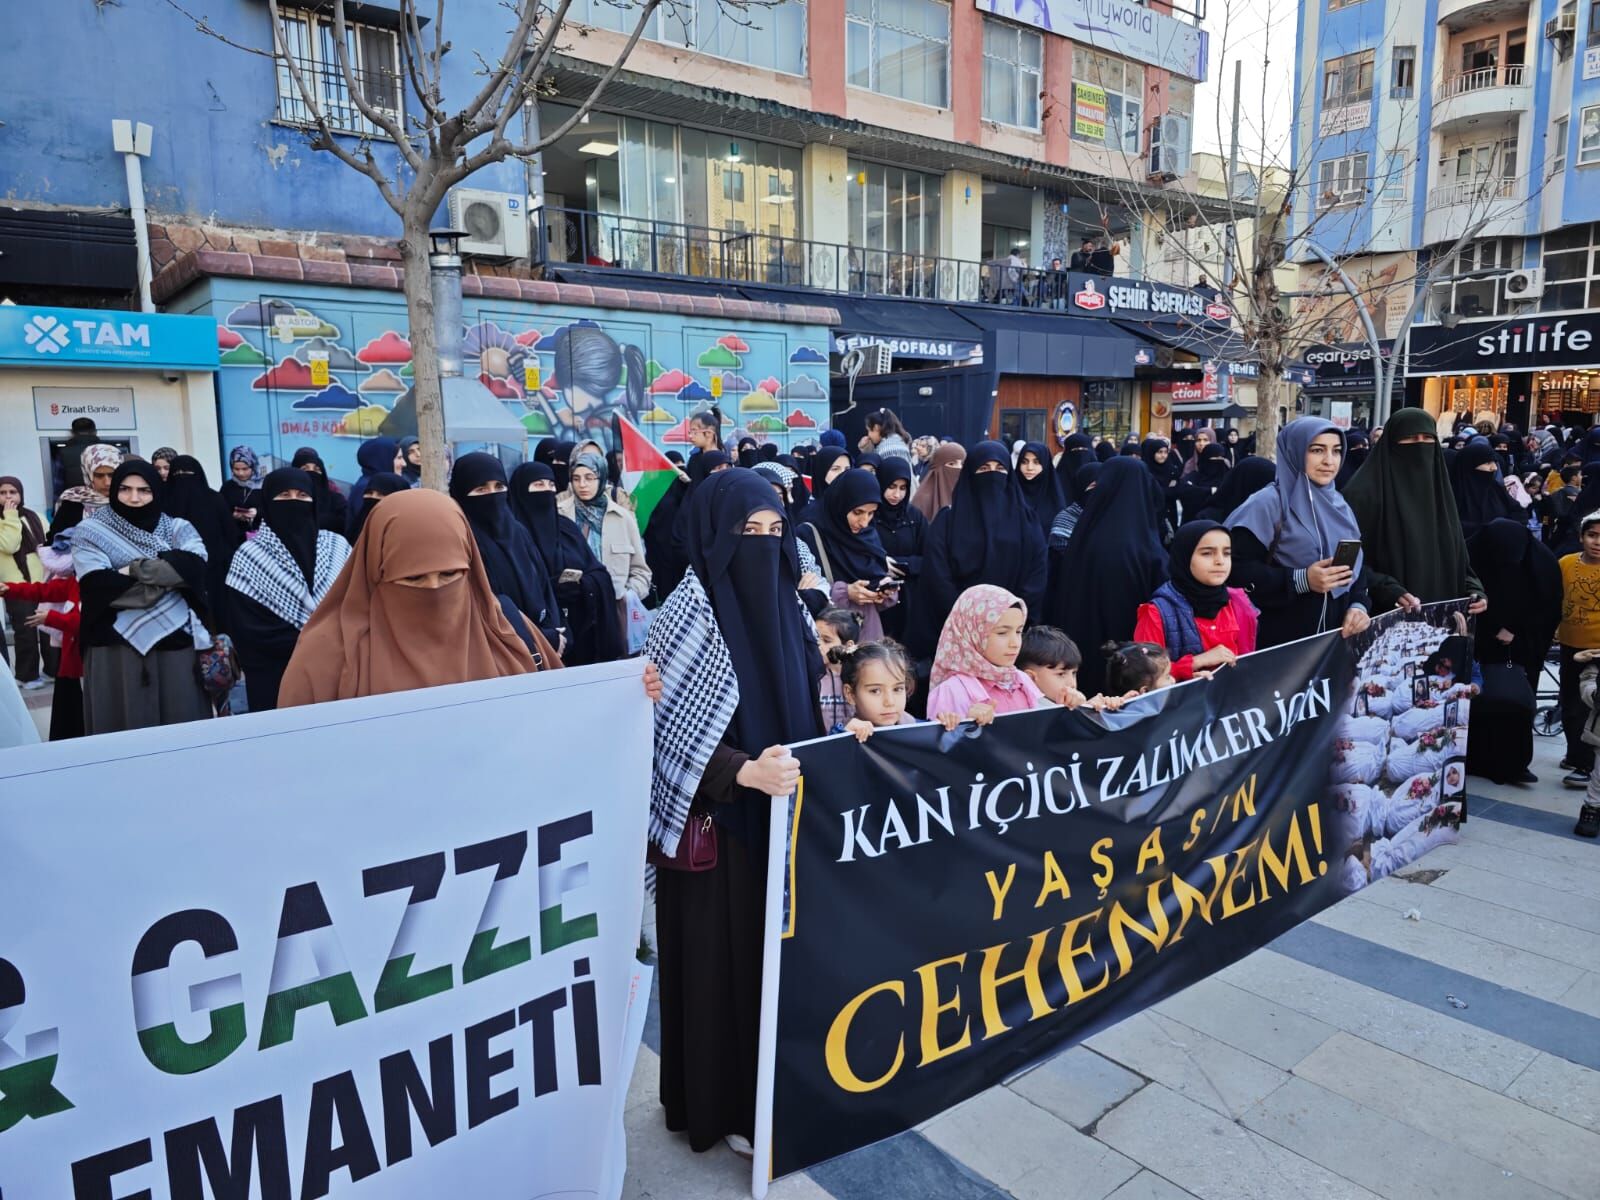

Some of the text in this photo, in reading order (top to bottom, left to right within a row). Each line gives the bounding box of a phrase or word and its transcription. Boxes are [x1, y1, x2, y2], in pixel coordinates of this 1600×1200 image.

[1109, 282, 1148, 313] ŞEHİR
[1151, 291, 1203, 316] SOFRASI
[72, 320, 150, 347] TAM
[889, 339, 953, 356] SOFRASI
[1477, 320, 1593, 356] stilife
[61, 404, 120, 414] Ziraat Bankası
[837, 787, 954, 862] KAN
[968, 752, 1091, 835] İÇİCİ
[1096, 707, 1274, 804] ZALİMLER
[131, 810, 600, 1077] GAZZE
[825, 804, 1325, 1092] CEHENNEM!
